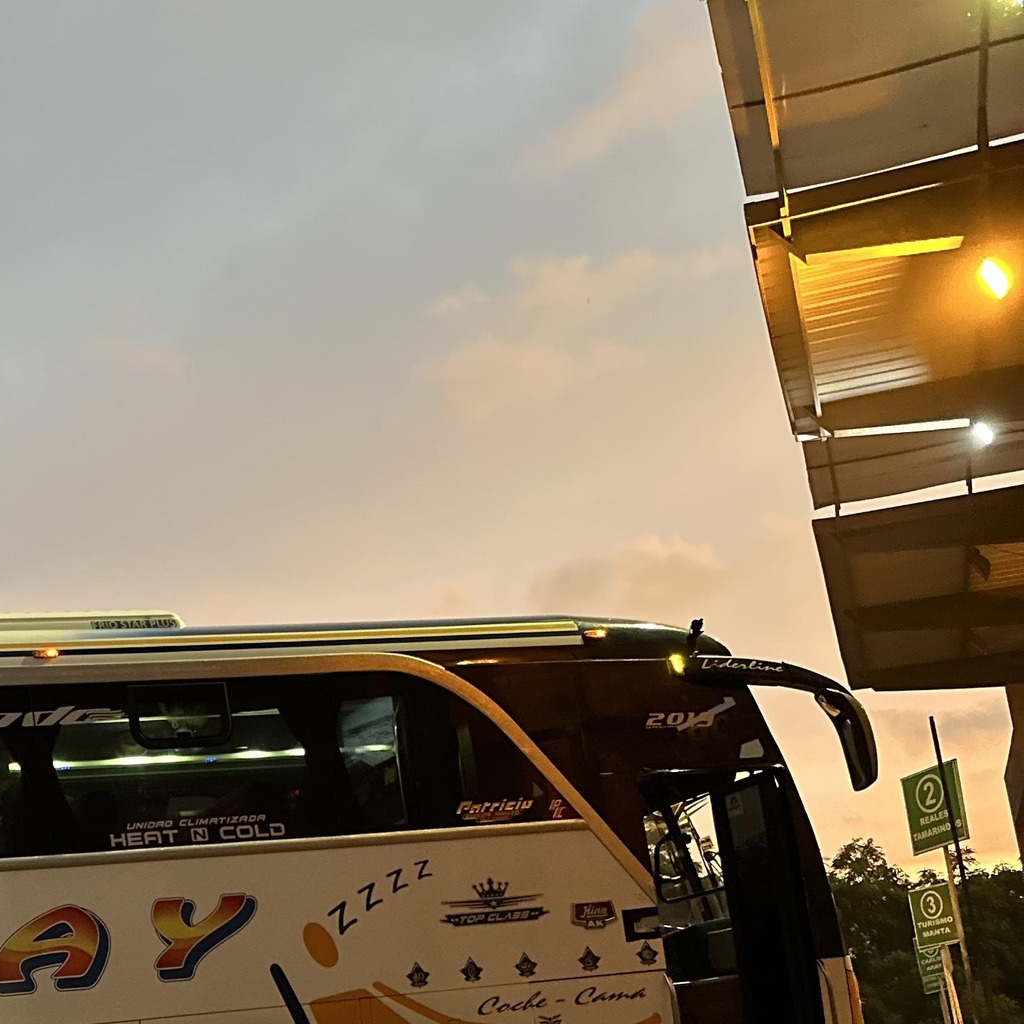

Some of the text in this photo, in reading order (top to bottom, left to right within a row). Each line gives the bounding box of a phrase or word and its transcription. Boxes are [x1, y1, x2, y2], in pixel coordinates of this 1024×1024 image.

[91, 619, 177, 629] FRIO STAR PLUS
[923, 781, 936, 806] 2
[126, 814, 266, 831] UNIDAD CLIMATIZADA
[919, 809, 949, 826] REALES
[109, 829, 179, 848] HEAT
[219, 822, 286, 840] COLD
[913, 818, 962, 841] TAMARINDS
[926, 896, 936, 914] 3
[460, 910, 530, 924] TOP CLASS
[917, 915, 954, 929] TURISMO
[922, 926, 951, 938] MANTA
[477, 991, 548, 1016] Coche
[575, 986, 646, 1006] Cama
